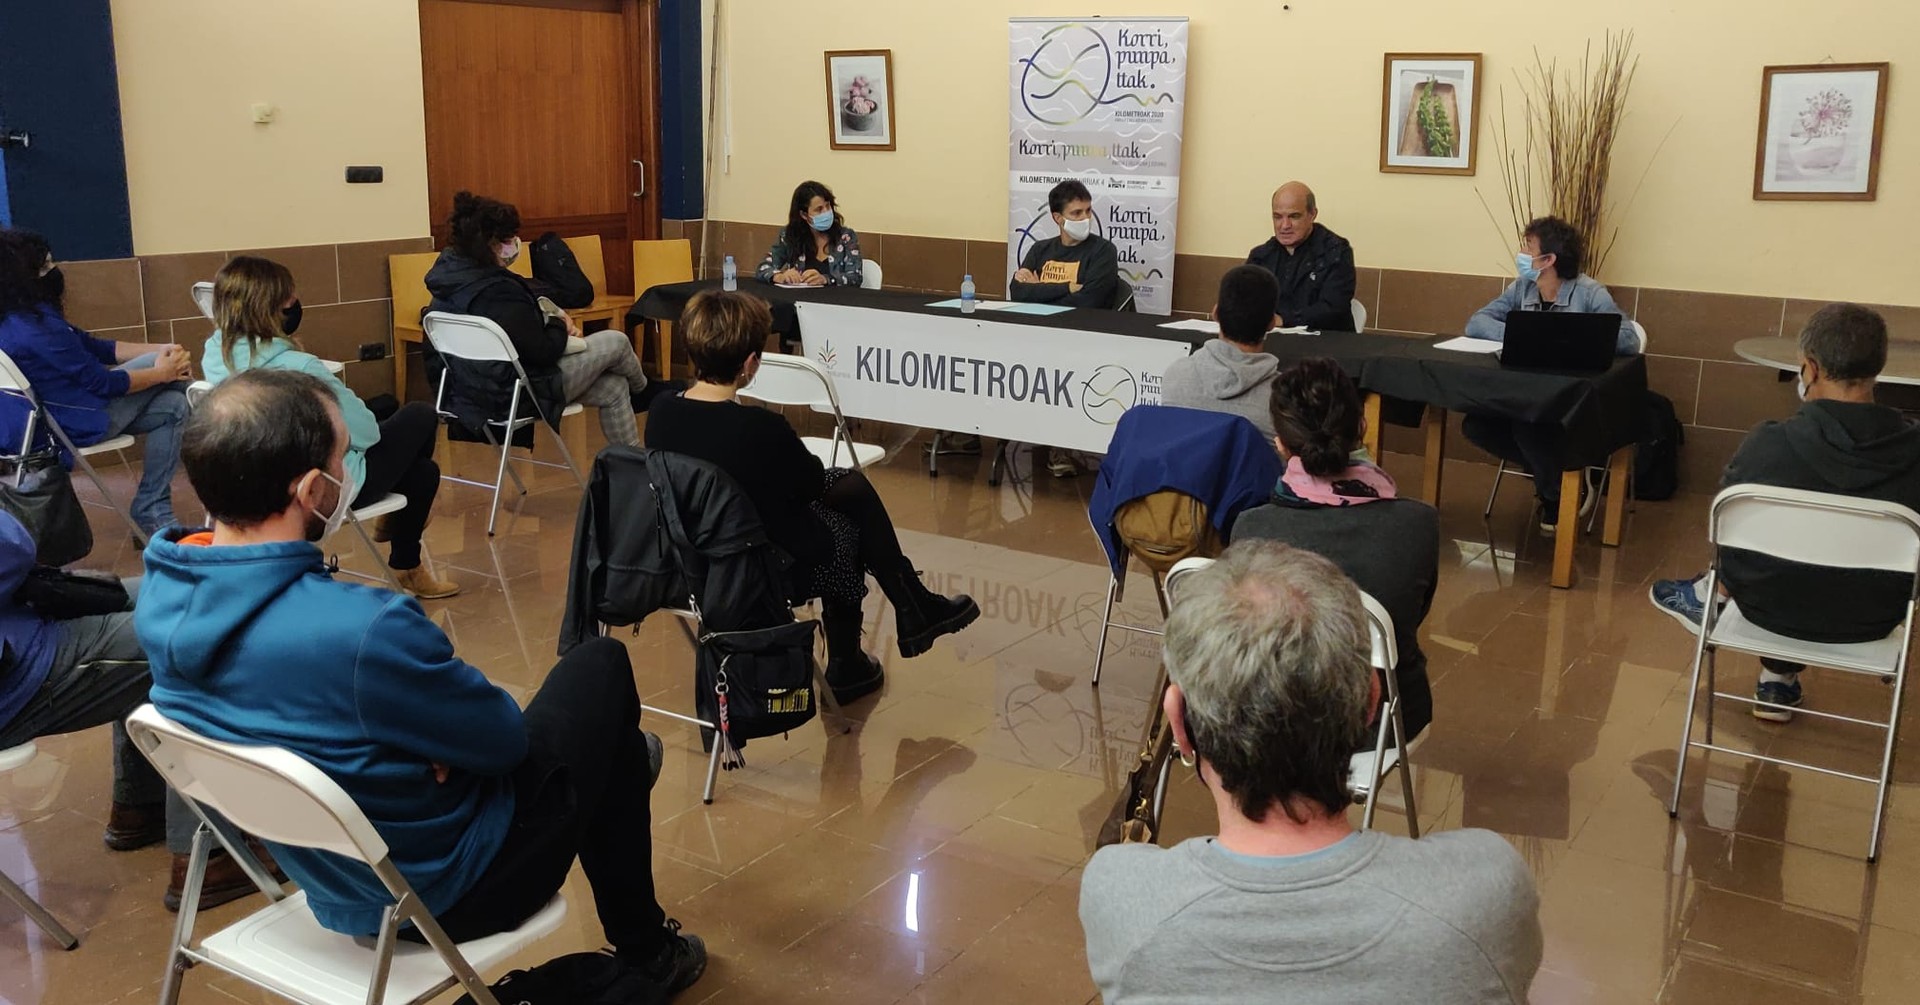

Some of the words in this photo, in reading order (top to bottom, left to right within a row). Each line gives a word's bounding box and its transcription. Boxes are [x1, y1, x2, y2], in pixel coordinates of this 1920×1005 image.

[1118, 28, 1169, 49] Korri,
[1115, 50, 1176, 70] punpa,
[1117, 69, 1156, 89] ttak.
[1019, 175, 1062, 184] KILOMETROAK
[1110, 205, 1158, 226] Korri,
[1107, 226, 1166, 246] punpa,
[1117, 244, 1146, 265] ak.
[855, 345, 1076, 408] KILOMETROAK
[1140, 384, 1161, 396] pun
